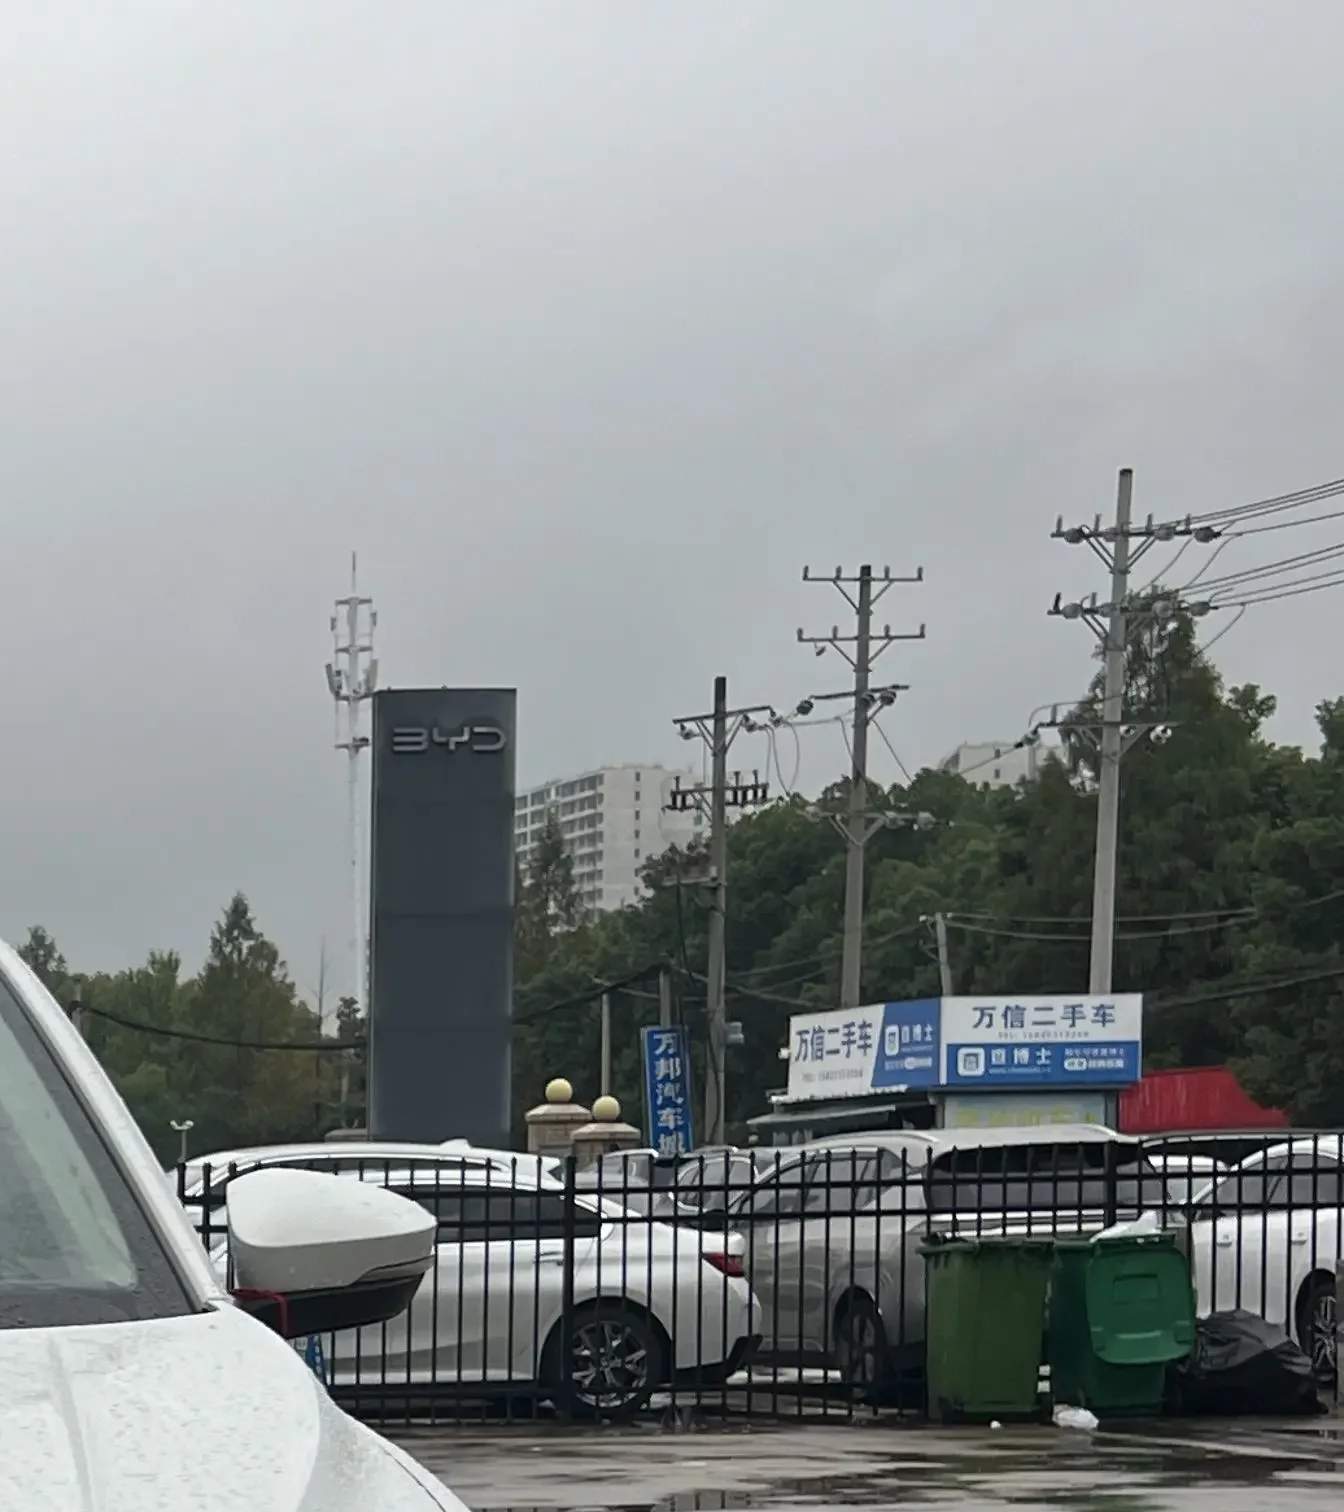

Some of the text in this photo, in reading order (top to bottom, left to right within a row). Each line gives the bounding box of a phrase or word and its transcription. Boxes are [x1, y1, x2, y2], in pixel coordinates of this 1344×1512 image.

[393, 726, 507, 751] BYD
[969, 1003, 1116, 1029] 万信二手车
[794, 1019, 873, 1062] 万信二手车
